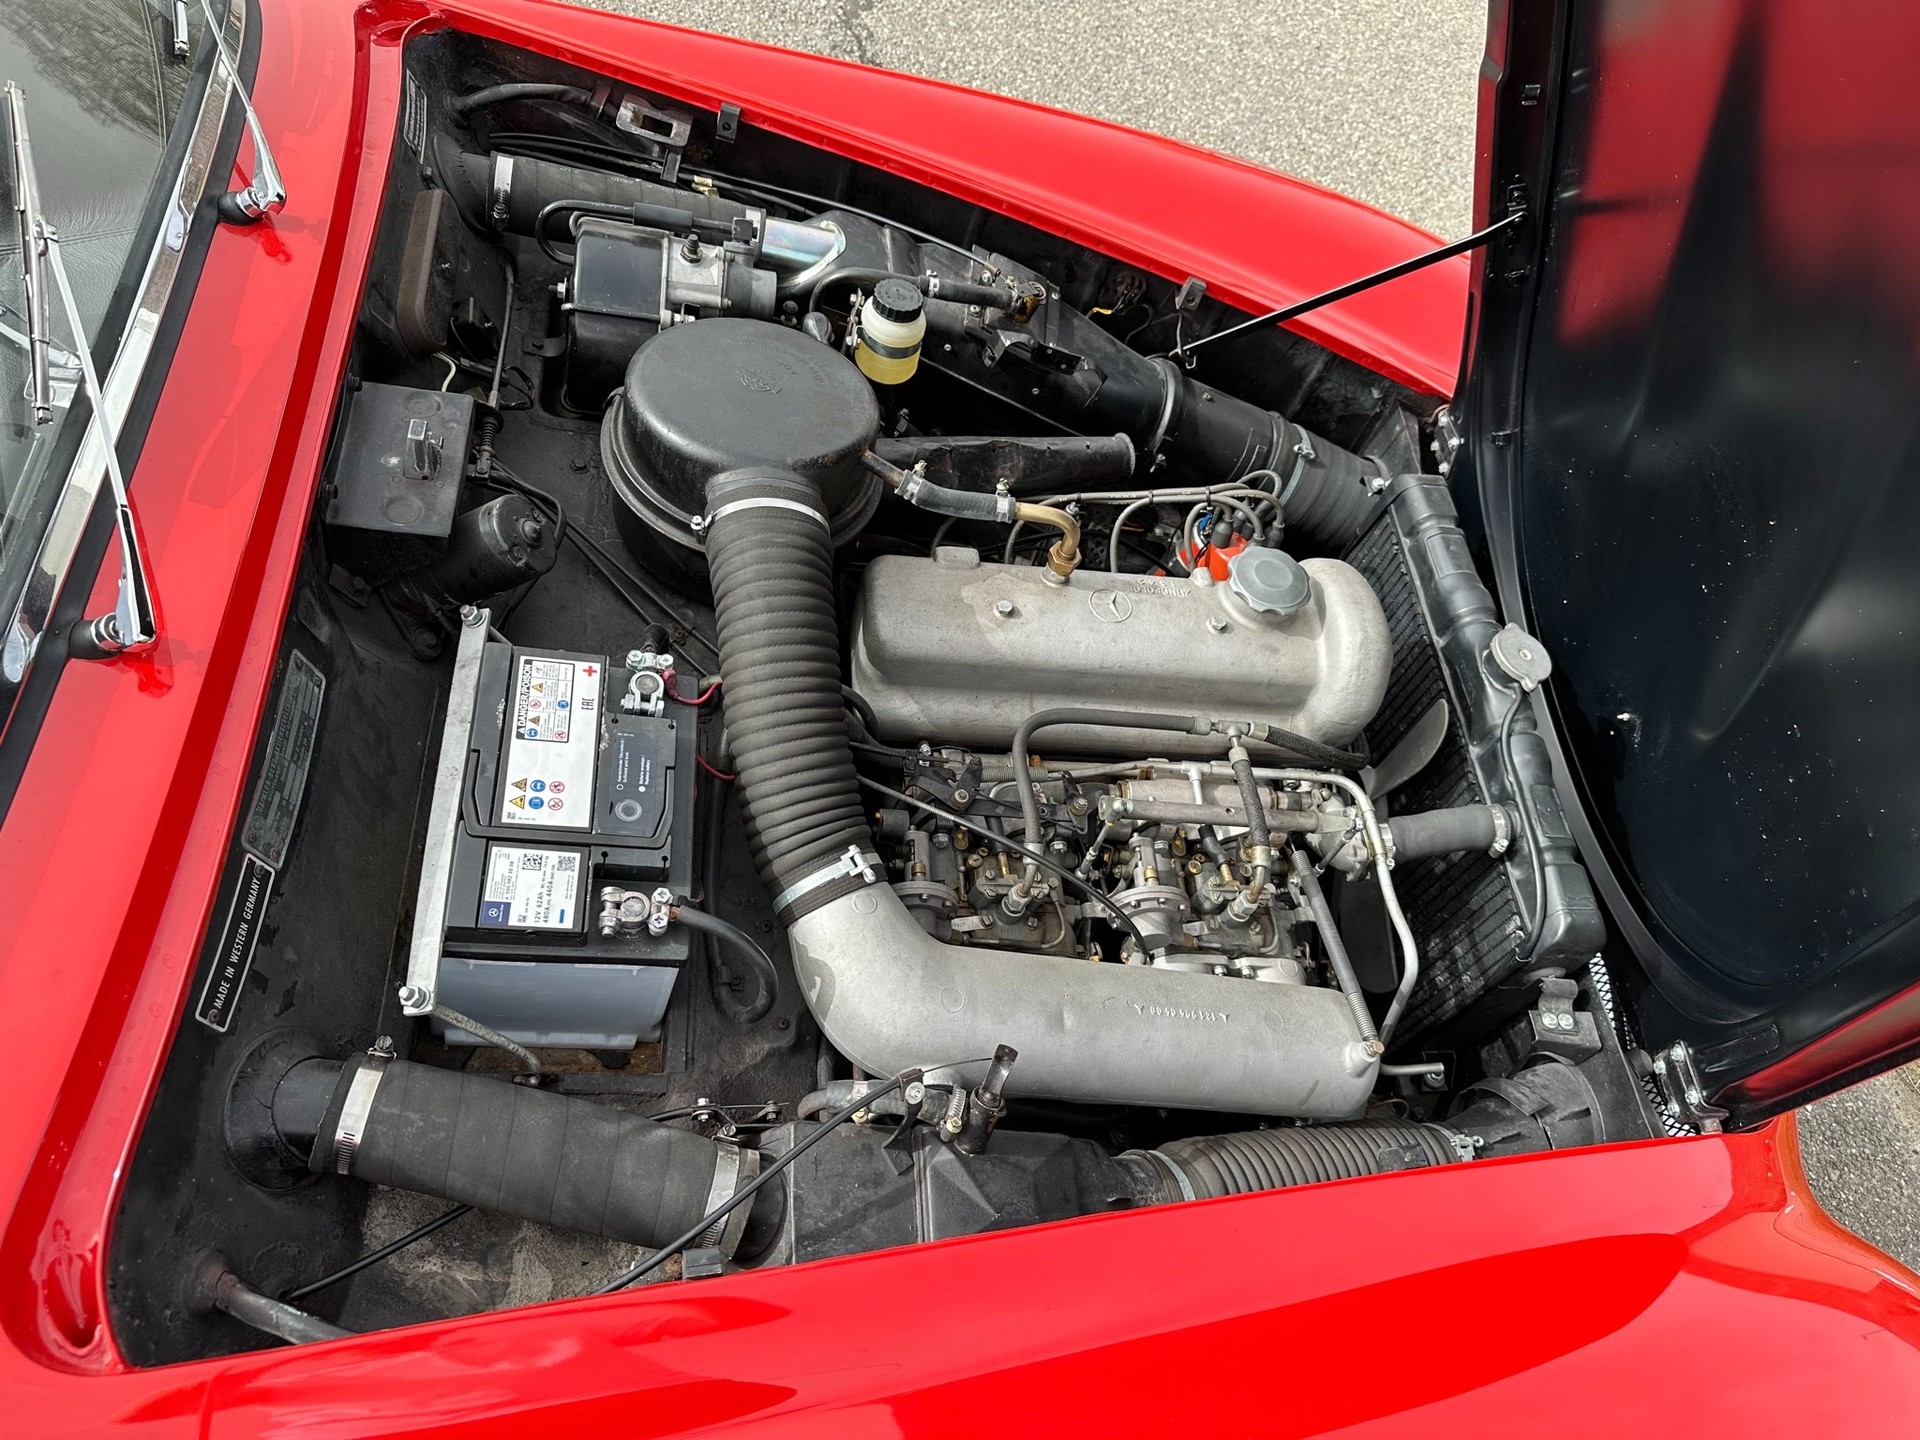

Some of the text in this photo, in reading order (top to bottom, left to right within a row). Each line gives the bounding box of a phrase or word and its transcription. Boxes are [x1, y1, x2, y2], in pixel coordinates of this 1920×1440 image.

[518, 664, 532, 726] DANGER/POISON
[214, 876, 261, 1009] MADE IN WESTERN GERMANY
[542, 906, 550, 923] 480A
